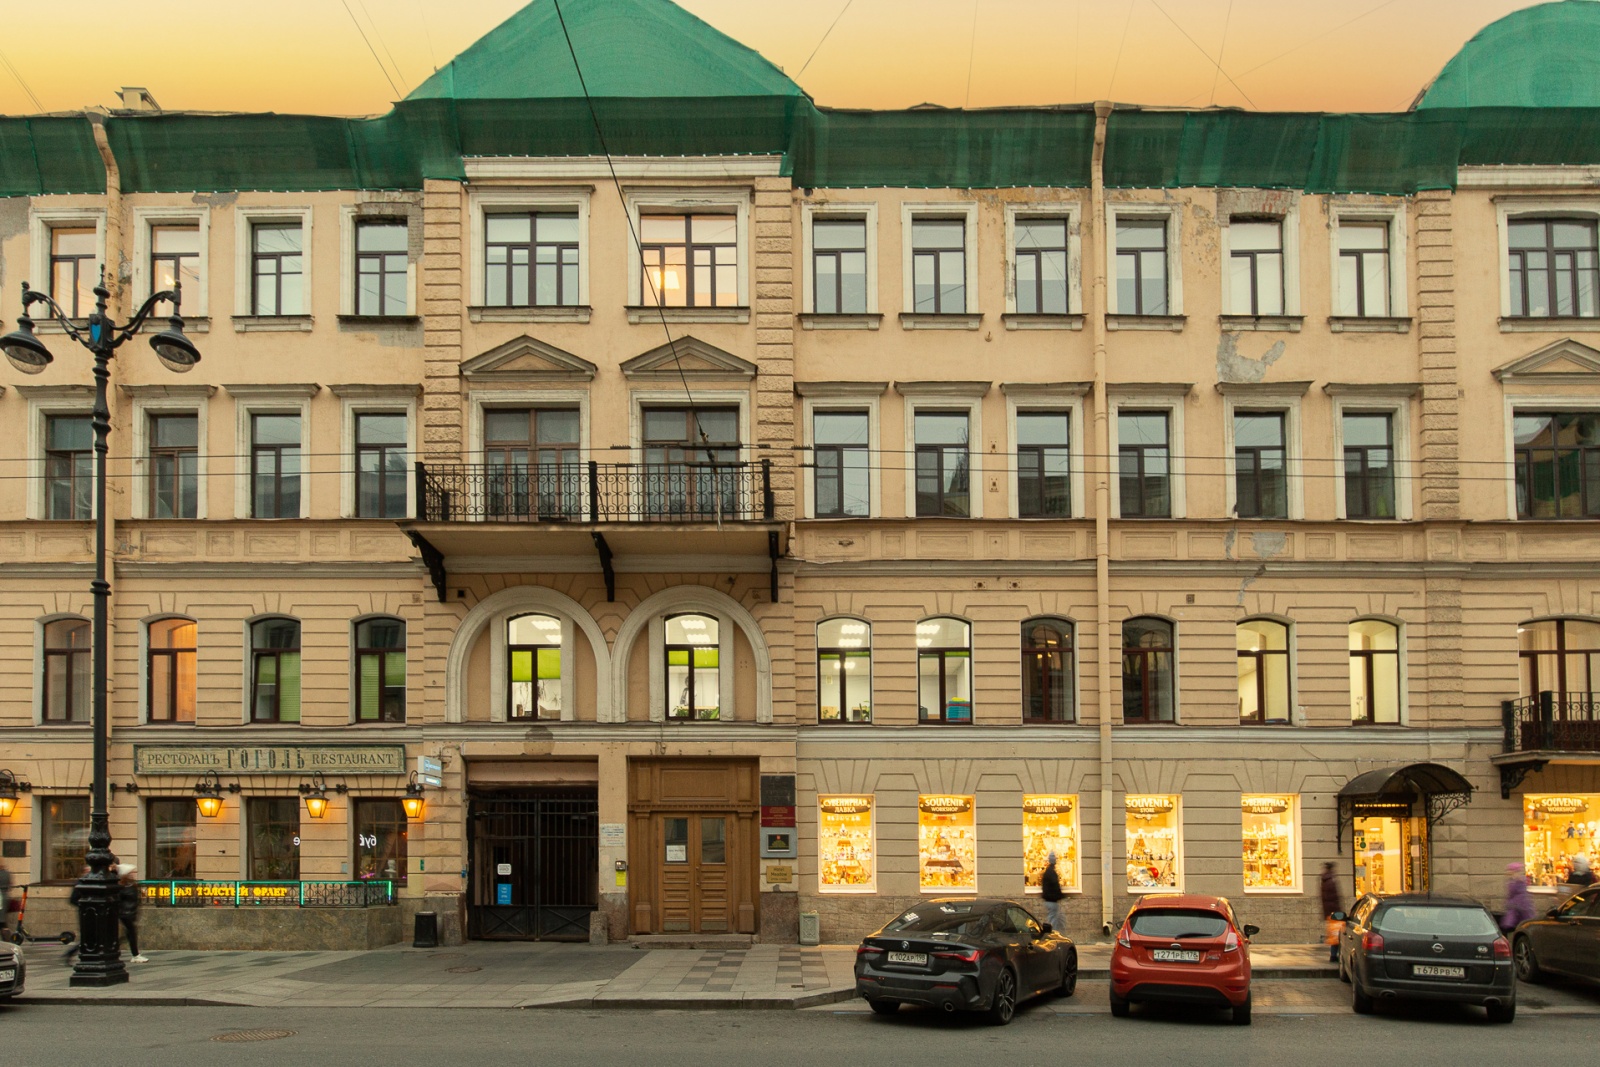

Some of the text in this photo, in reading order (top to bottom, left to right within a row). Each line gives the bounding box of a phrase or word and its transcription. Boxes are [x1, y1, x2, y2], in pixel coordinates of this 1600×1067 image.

[146, 748, 306, 770] РЕСТОРАНЪ ГОГОЛЬ
[311, 753, 394, 765] RESTAURANT
[925, 797, 964, 807] SOUVENIR
[1125, 797, 1170, 808] SOUVENIR
[1541, 797, 1583, 807] SOUVENIR
